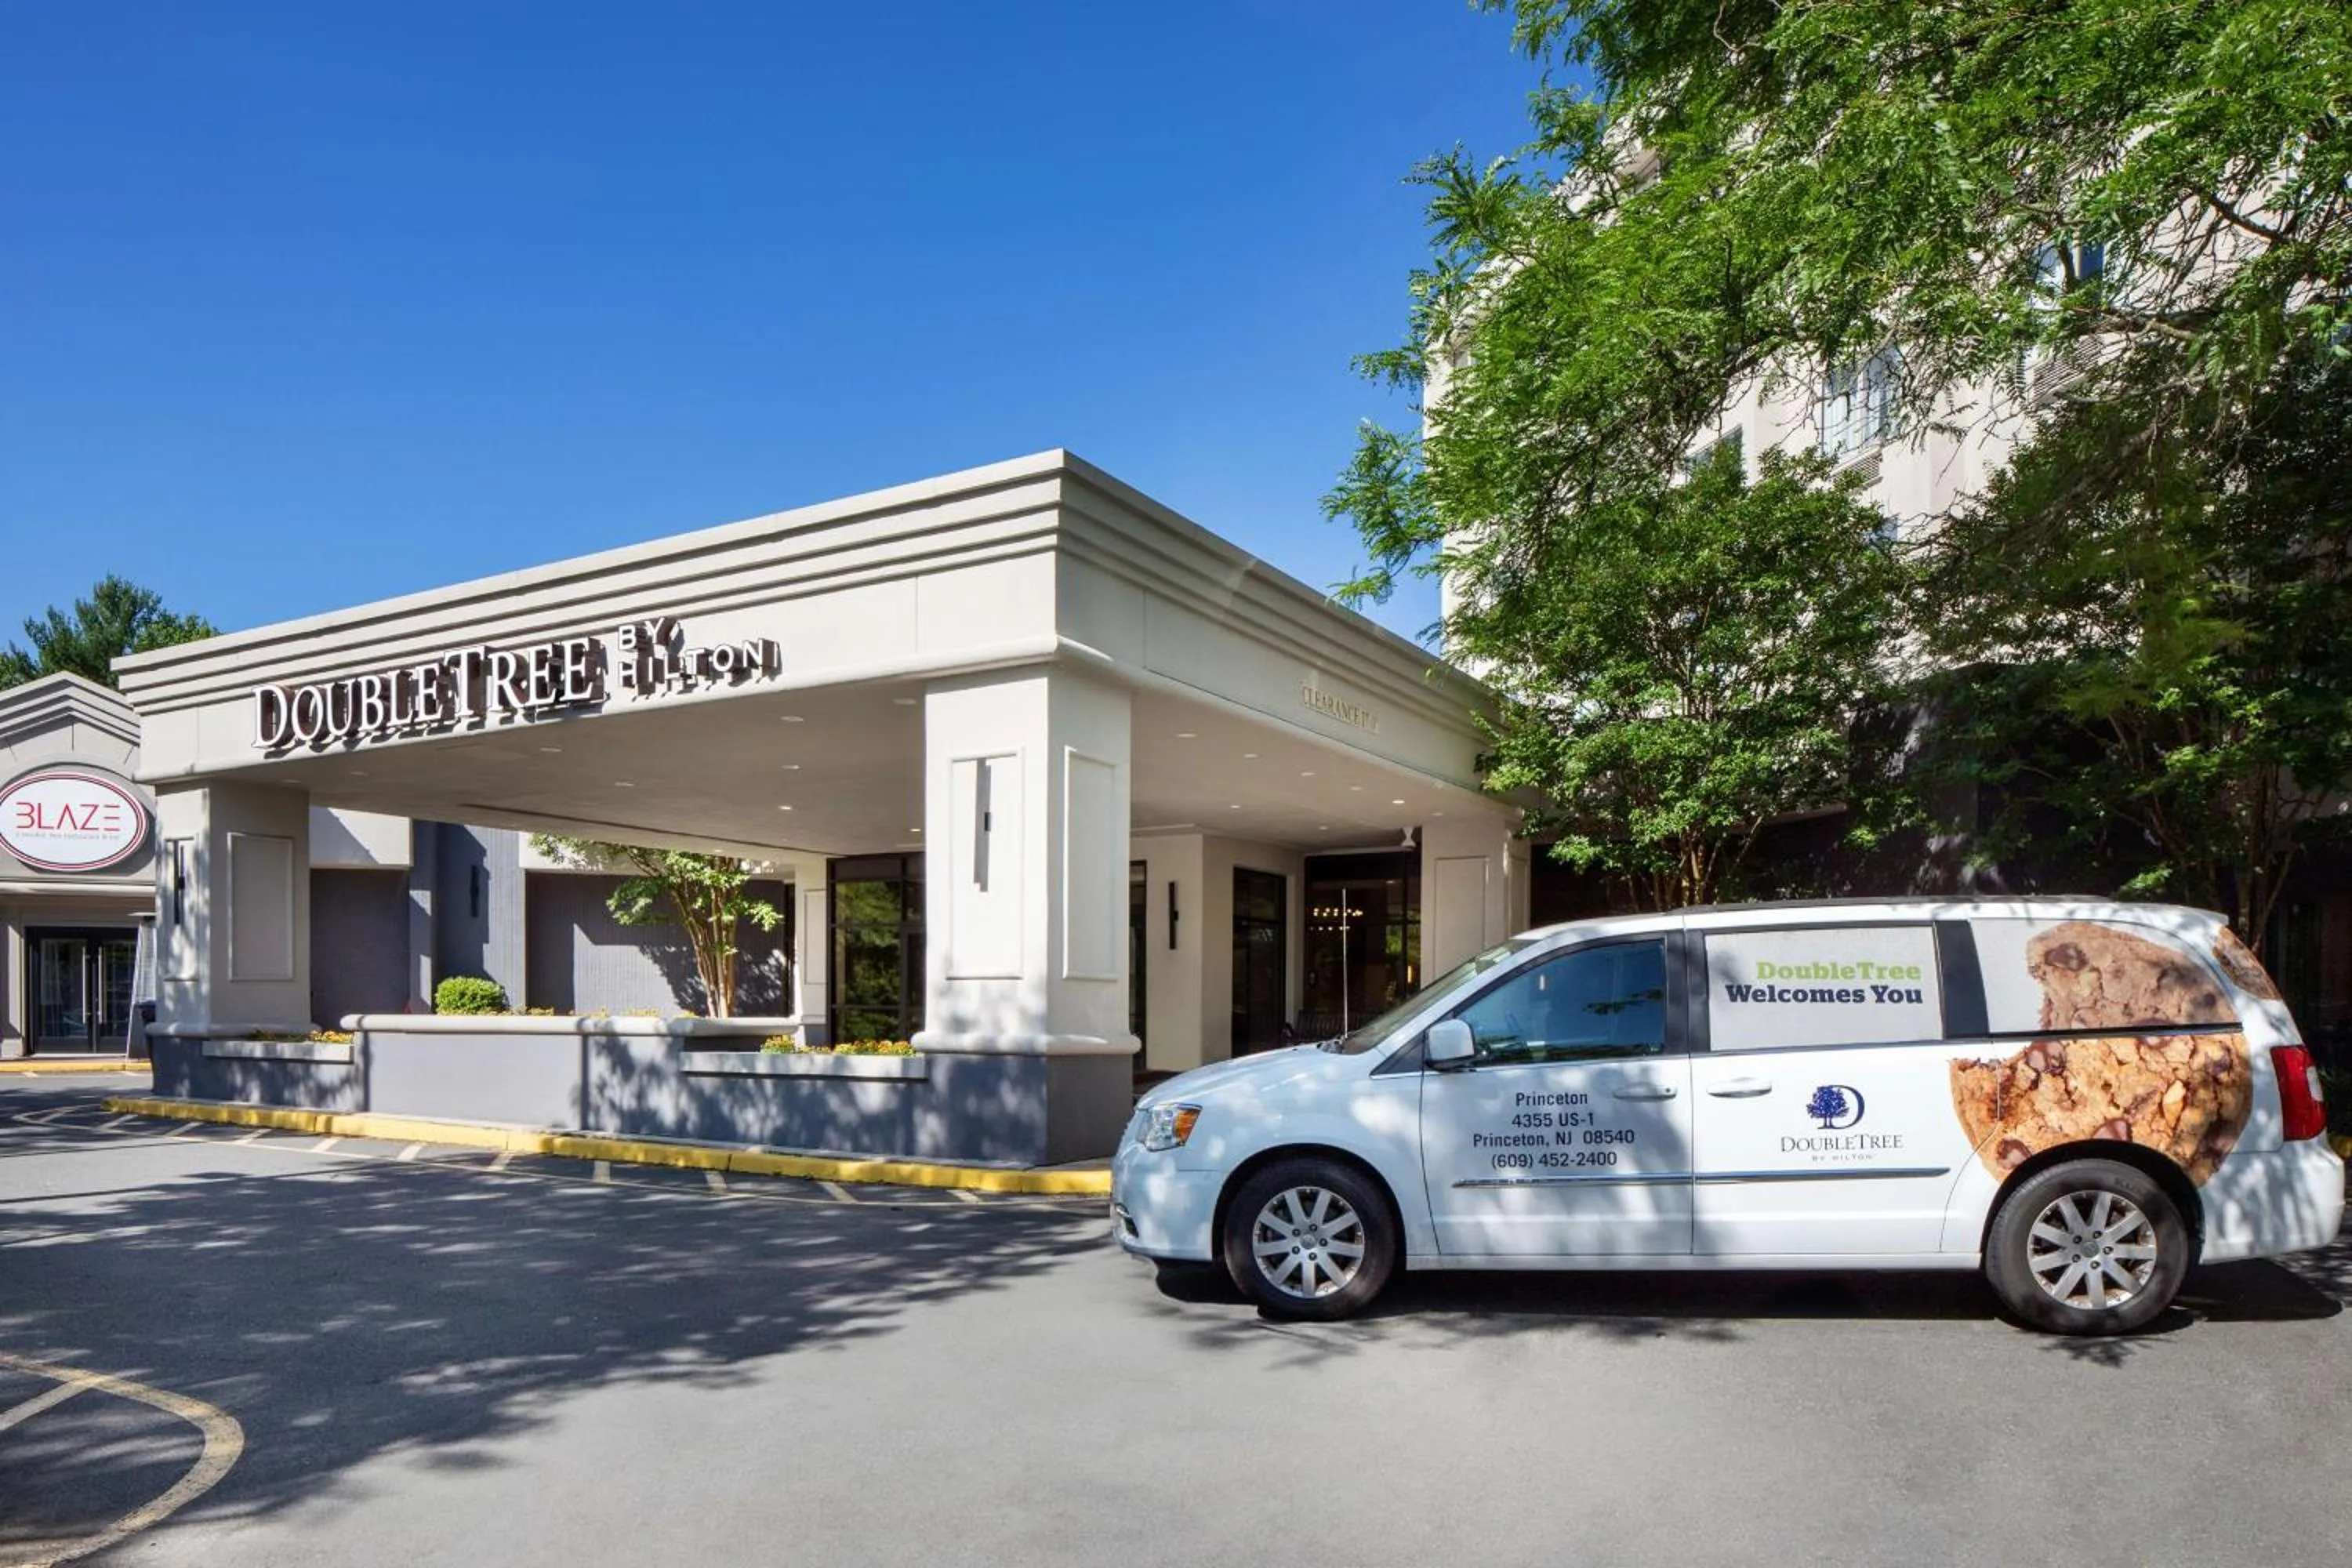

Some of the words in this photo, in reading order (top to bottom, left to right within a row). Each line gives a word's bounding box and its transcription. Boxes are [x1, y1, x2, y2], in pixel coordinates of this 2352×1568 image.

[619, 617, 666, 650] BY
[619, 638, 764, 688] HILTON
[16, 802, 120, 831] BLAZE
[1756, 962, 1921, 980] DoubleTree
[1725, 985, 1866, 1003] Welcomes
[1870, 985, 1923, 1004] You
[1515, 1092, 1588, 1106] Princeton
[1512, 1112, 1553, 1127] 4355
[1558, 1112, 1594, 1127] US-1
[1473, 1133, 1550, 1147] Princeton,
[1555, 1131, 1572, 1145] NJ
[1583, 1129, 1635, 1145] 08540
[1491, 1154, 1534, 1170] (609)
[1538, 1152, 1617, 1167] 452-2400
